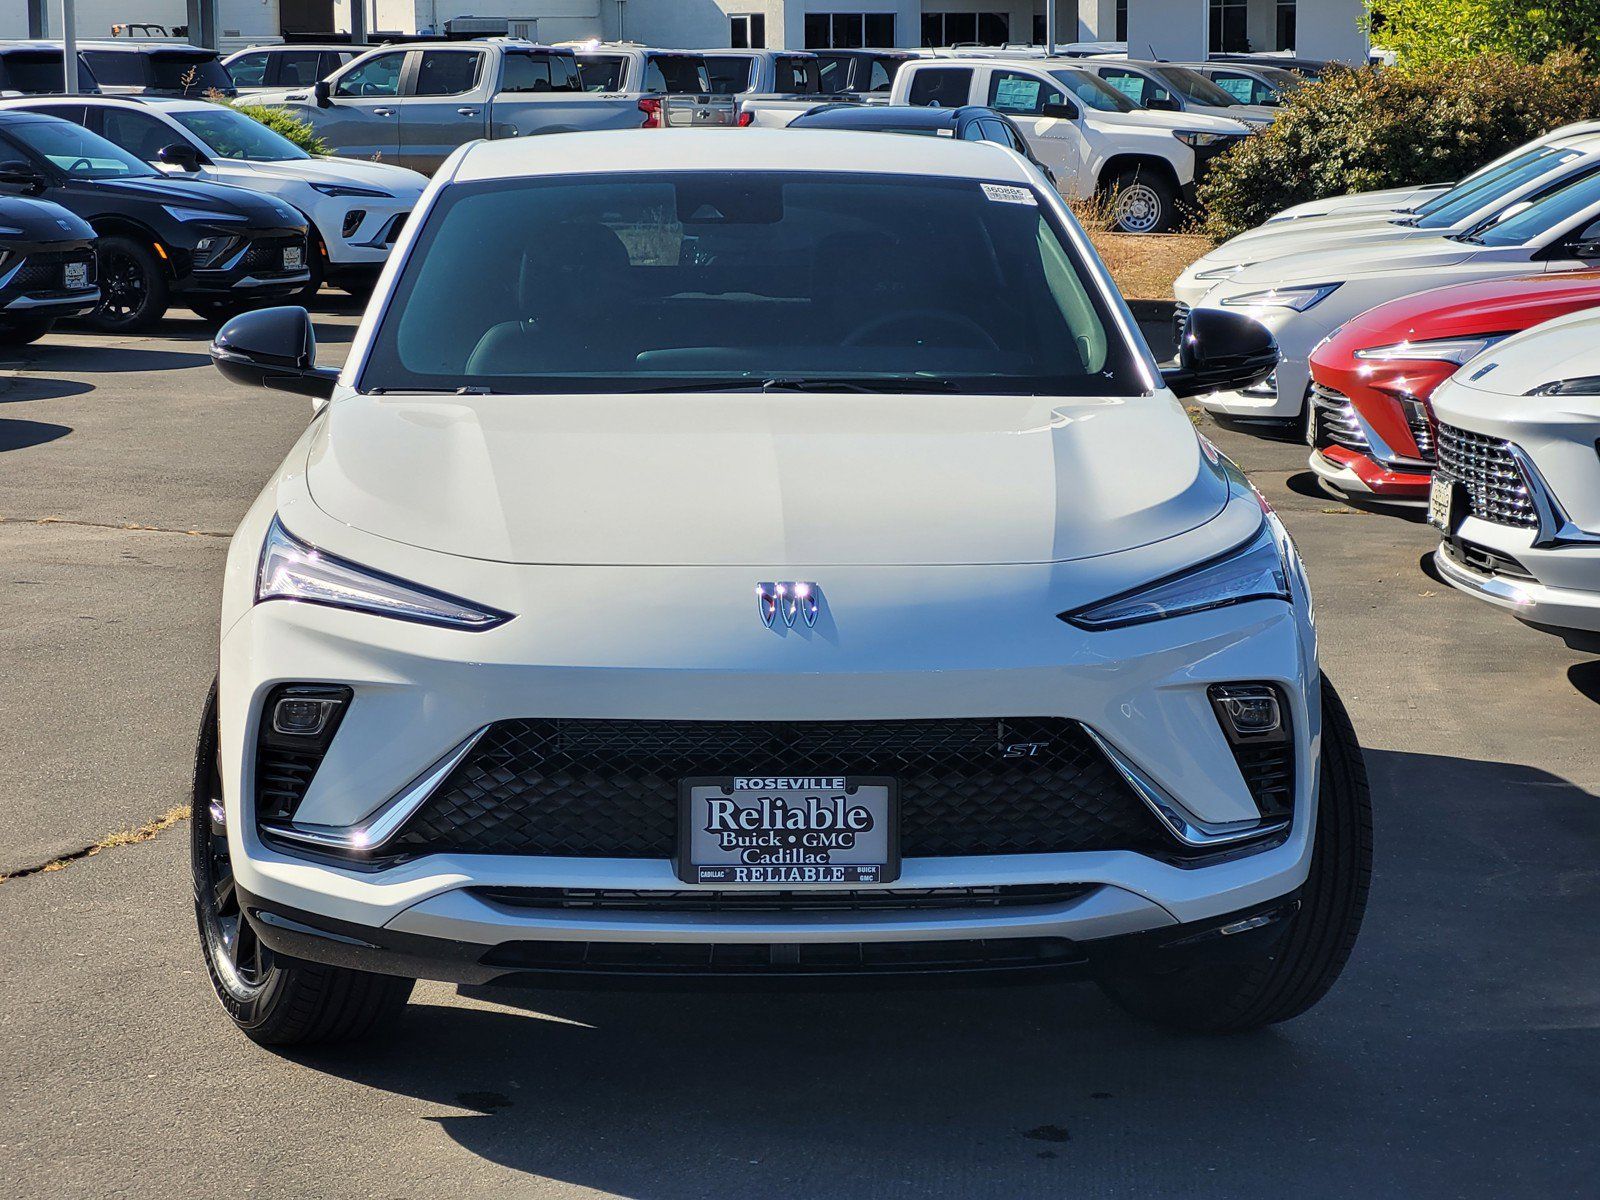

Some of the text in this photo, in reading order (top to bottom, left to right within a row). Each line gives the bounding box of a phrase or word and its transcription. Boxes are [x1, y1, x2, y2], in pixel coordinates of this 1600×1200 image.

[1003, 742, 1050, 758] ST
[734, 778, 844, 790] ROSEVILLE
[707, 797, 869, 831] Reliable
[722, 831, 853, 847] Buick GMC
[742, 849, 828, 864] Cadillac
[700, 870, 725, 878] CADILLAC
[734, 867, 845, 882] RELIABLE
